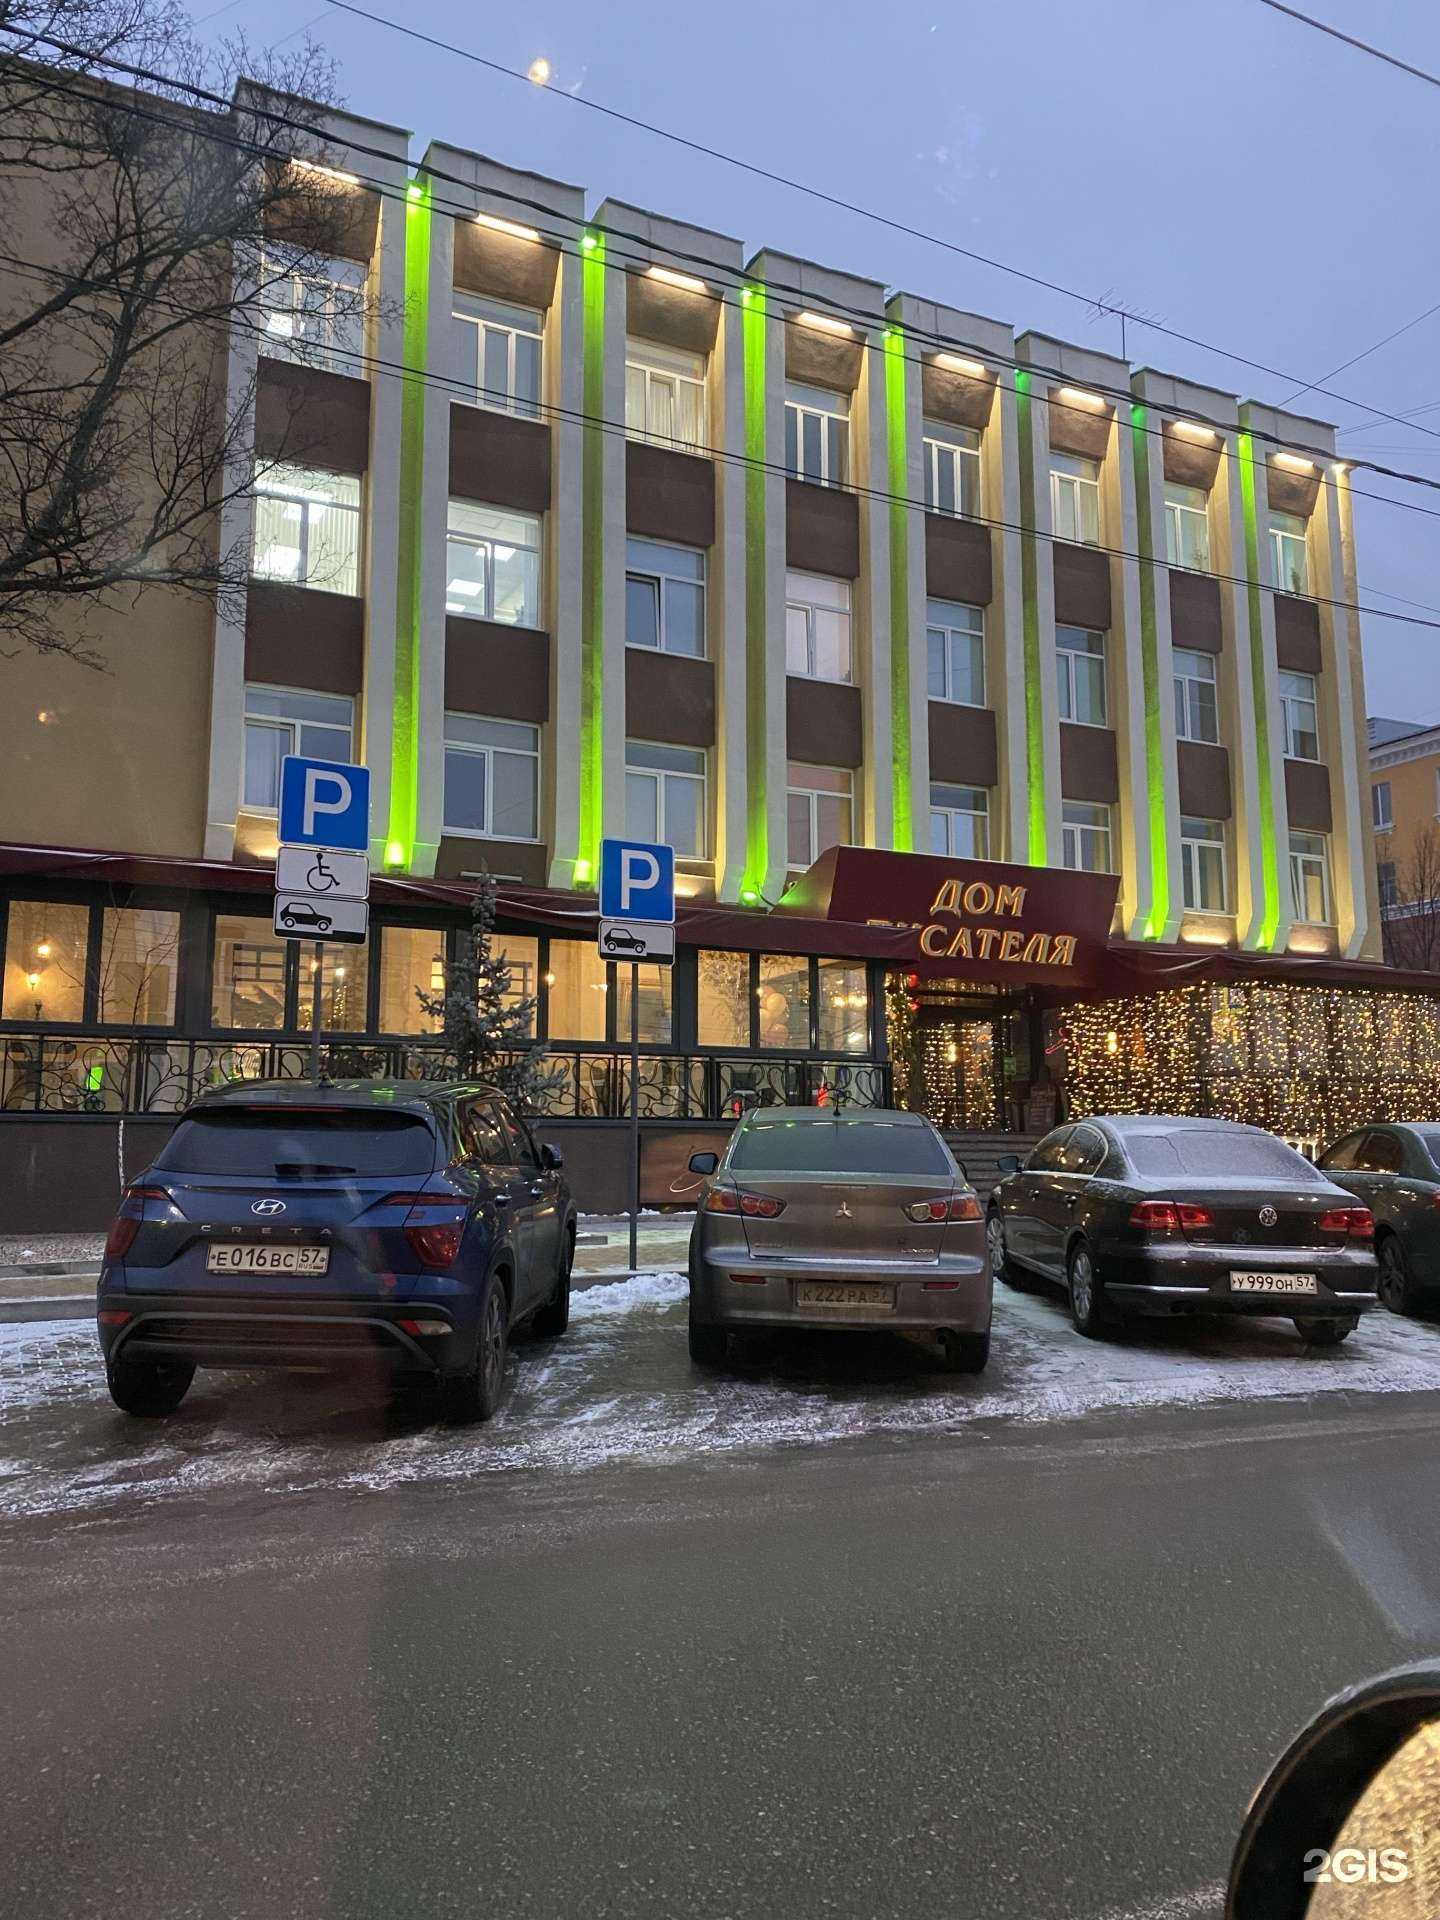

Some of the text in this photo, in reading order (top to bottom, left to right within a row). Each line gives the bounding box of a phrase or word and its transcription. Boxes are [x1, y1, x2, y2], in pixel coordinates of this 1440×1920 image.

[303, 768, 352, 835] P
[621, 848, 660, 910] P
[929, 879, 1027, 918] ДОМ
[866, 919, 1078, 966] САТЕЛЯ
[201, 1225, 332, 1235] CRETA
[300, 1249, 320, 1263] 57
[1296, 1276, 1310, 1287] 57
